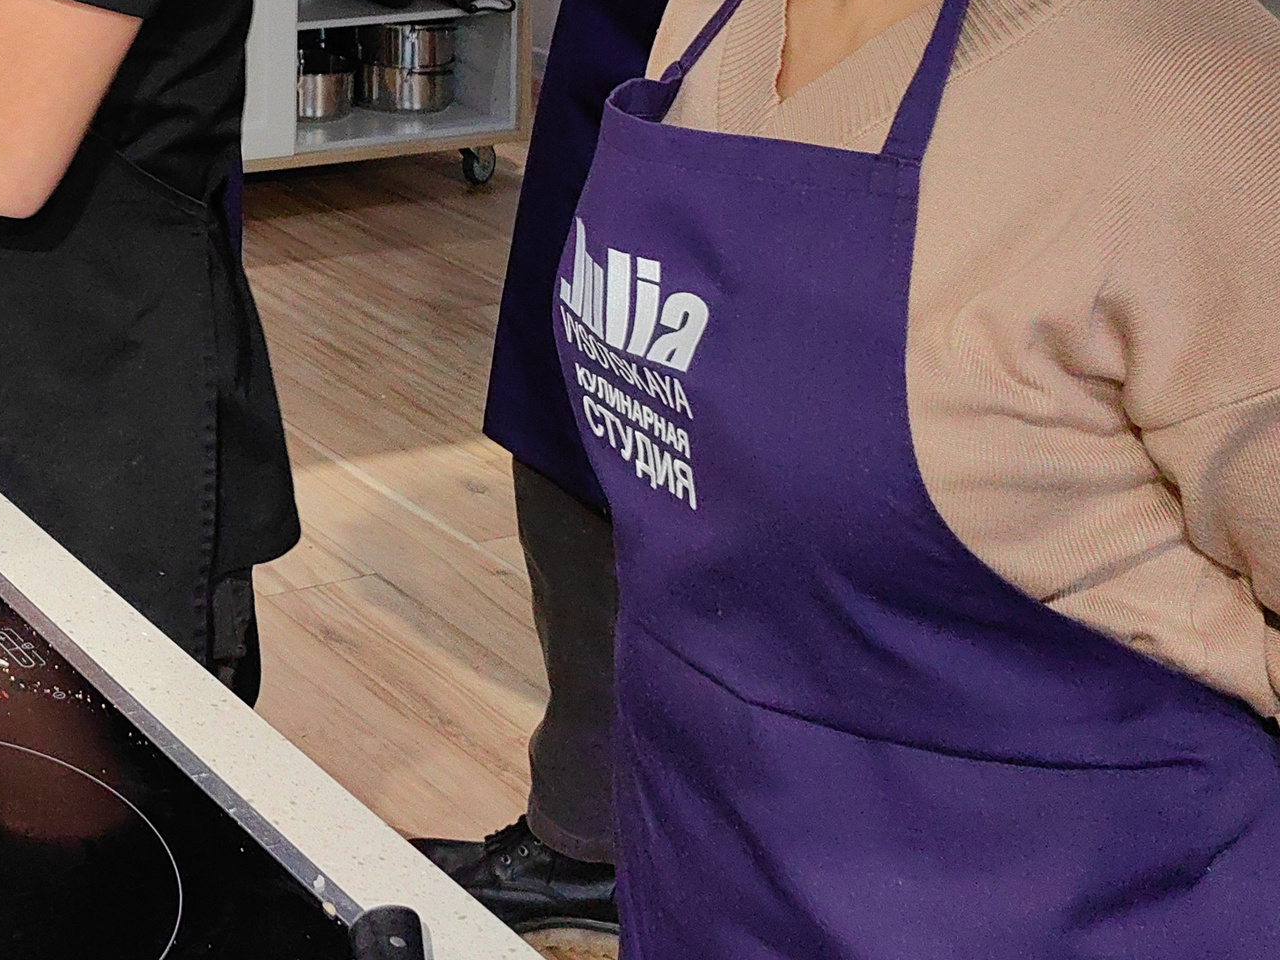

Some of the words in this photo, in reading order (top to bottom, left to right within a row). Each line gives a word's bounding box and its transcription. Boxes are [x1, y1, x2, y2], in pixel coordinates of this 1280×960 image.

[560, 216, 709, 373] Julia
[560, 305, 693, 420] VYSOTSKAYA
[575, 362, 690, 459] КУЛИНАРНАЯ
[583, 395, 697, 510] СТУДИЯ
